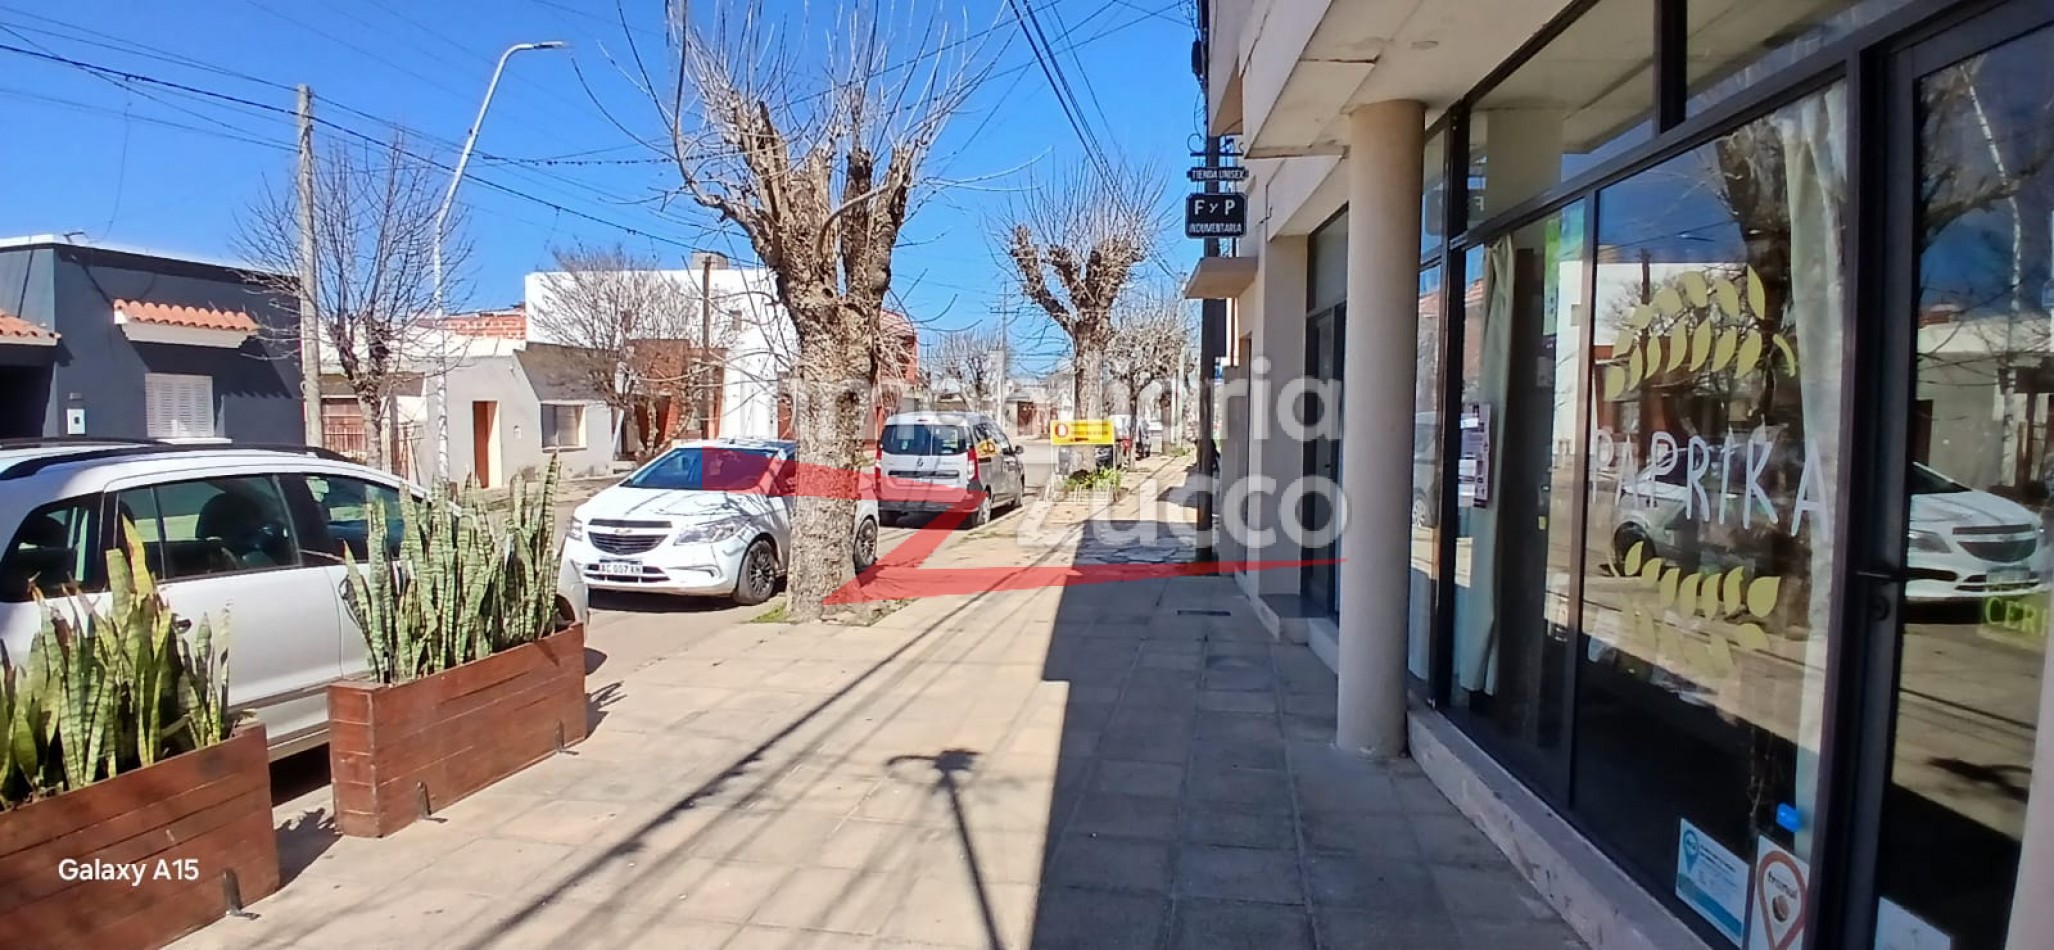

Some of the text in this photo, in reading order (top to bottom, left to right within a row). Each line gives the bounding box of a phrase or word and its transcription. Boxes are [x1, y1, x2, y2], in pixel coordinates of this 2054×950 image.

[1194, 199, 1205, 215] F
[1225, 199, 1236, 215] P
[1188, 222, 1242, 233] INDUMENTARIA
[1590, 430, 1831, 541] PAPRIKA
